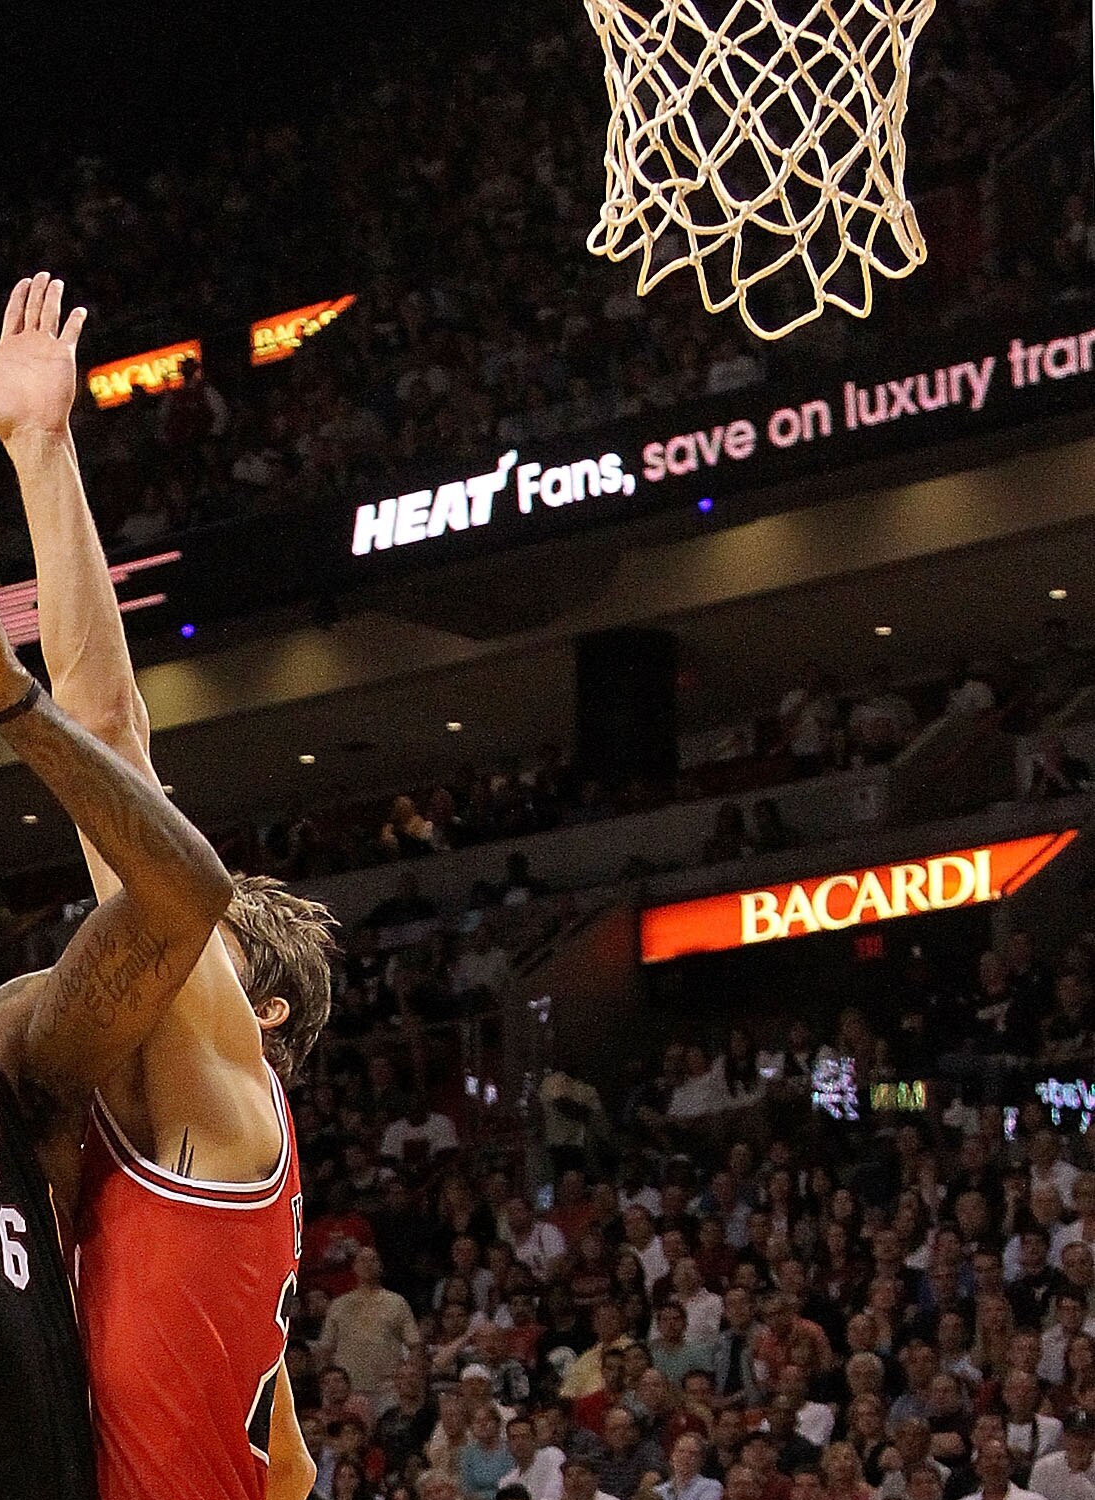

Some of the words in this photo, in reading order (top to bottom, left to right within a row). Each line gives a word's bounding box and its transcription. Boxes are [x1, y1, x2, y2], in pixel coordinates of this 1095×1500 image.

[352, 449, 518, 556] HEAT
[516, 453, 637, 514] Fans,
[643, 418, 757, 482] save
[768, 399, 831, 448] on
[844, 355, 996, 411] luxury
[739, 849, 992, 945] BACARDI
